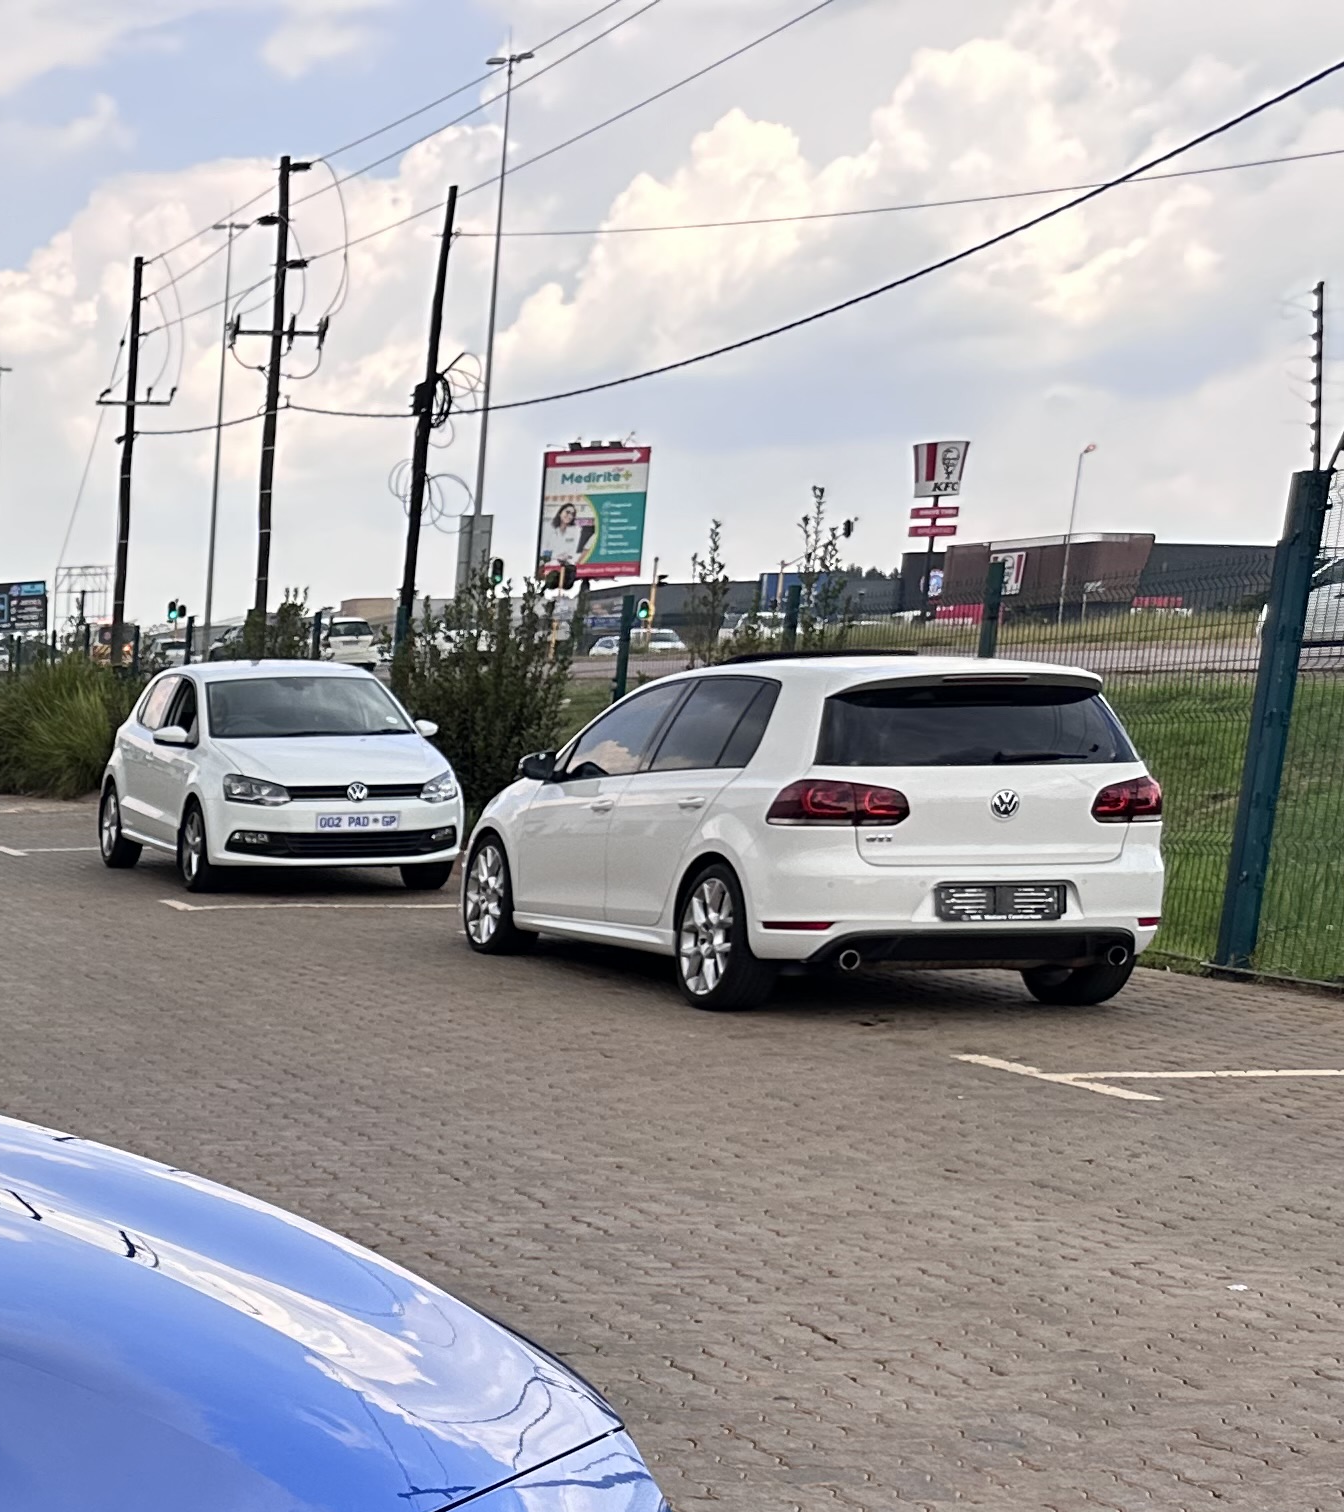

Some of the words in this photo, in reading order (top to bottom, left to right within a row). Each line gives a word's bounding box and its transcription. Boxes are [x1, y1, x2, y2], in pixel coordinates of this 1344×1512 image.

[932, 481, 959, 492] KFC
[348, 816, 369, 827] PAD
[381, 815, 397, 827] GP
